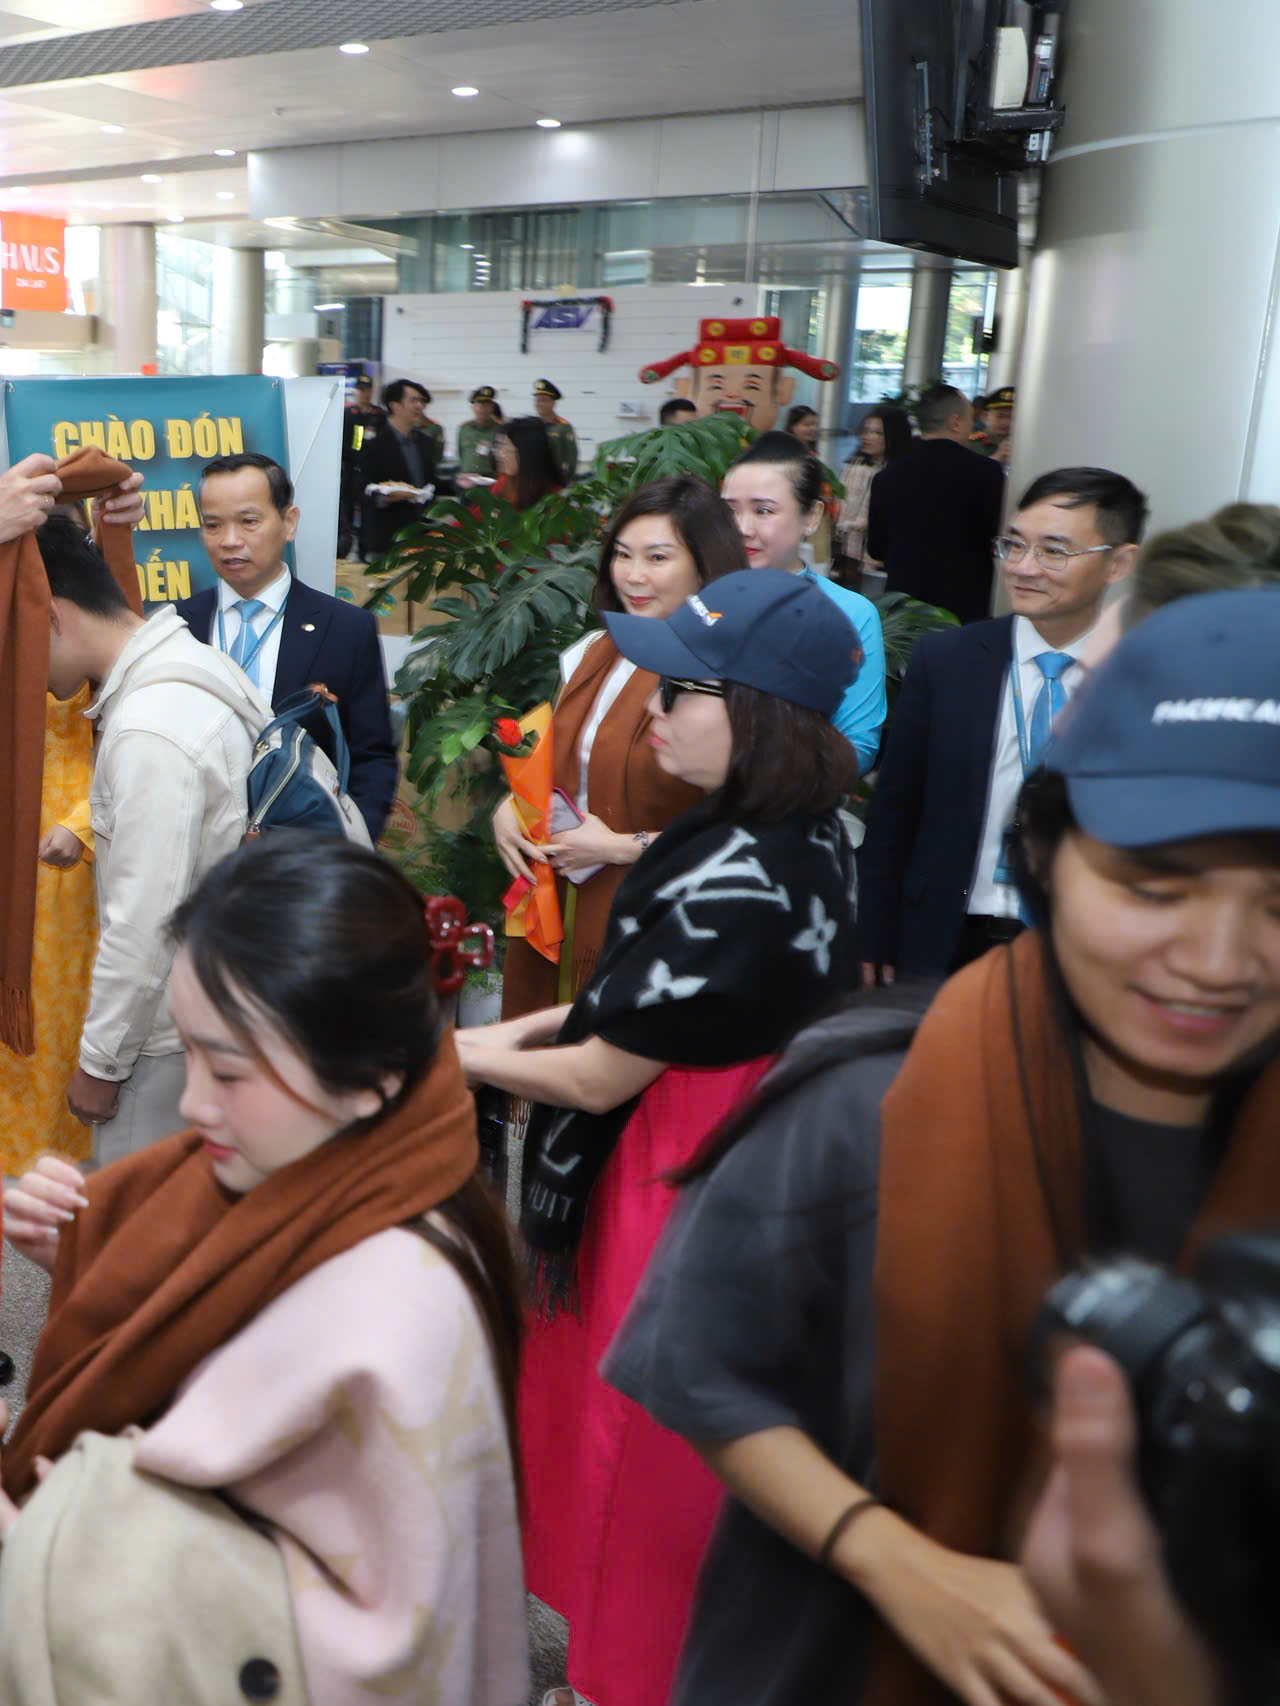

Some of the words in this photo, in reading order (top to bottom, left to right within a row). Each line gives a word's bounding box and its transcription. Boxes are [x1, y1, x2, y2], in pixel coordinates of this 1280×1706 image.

[53, 414, 156, 461] CHÀO
[165, 412, 245, 459] ĐÓN
[132, 483, 202, 532] KHÁ
